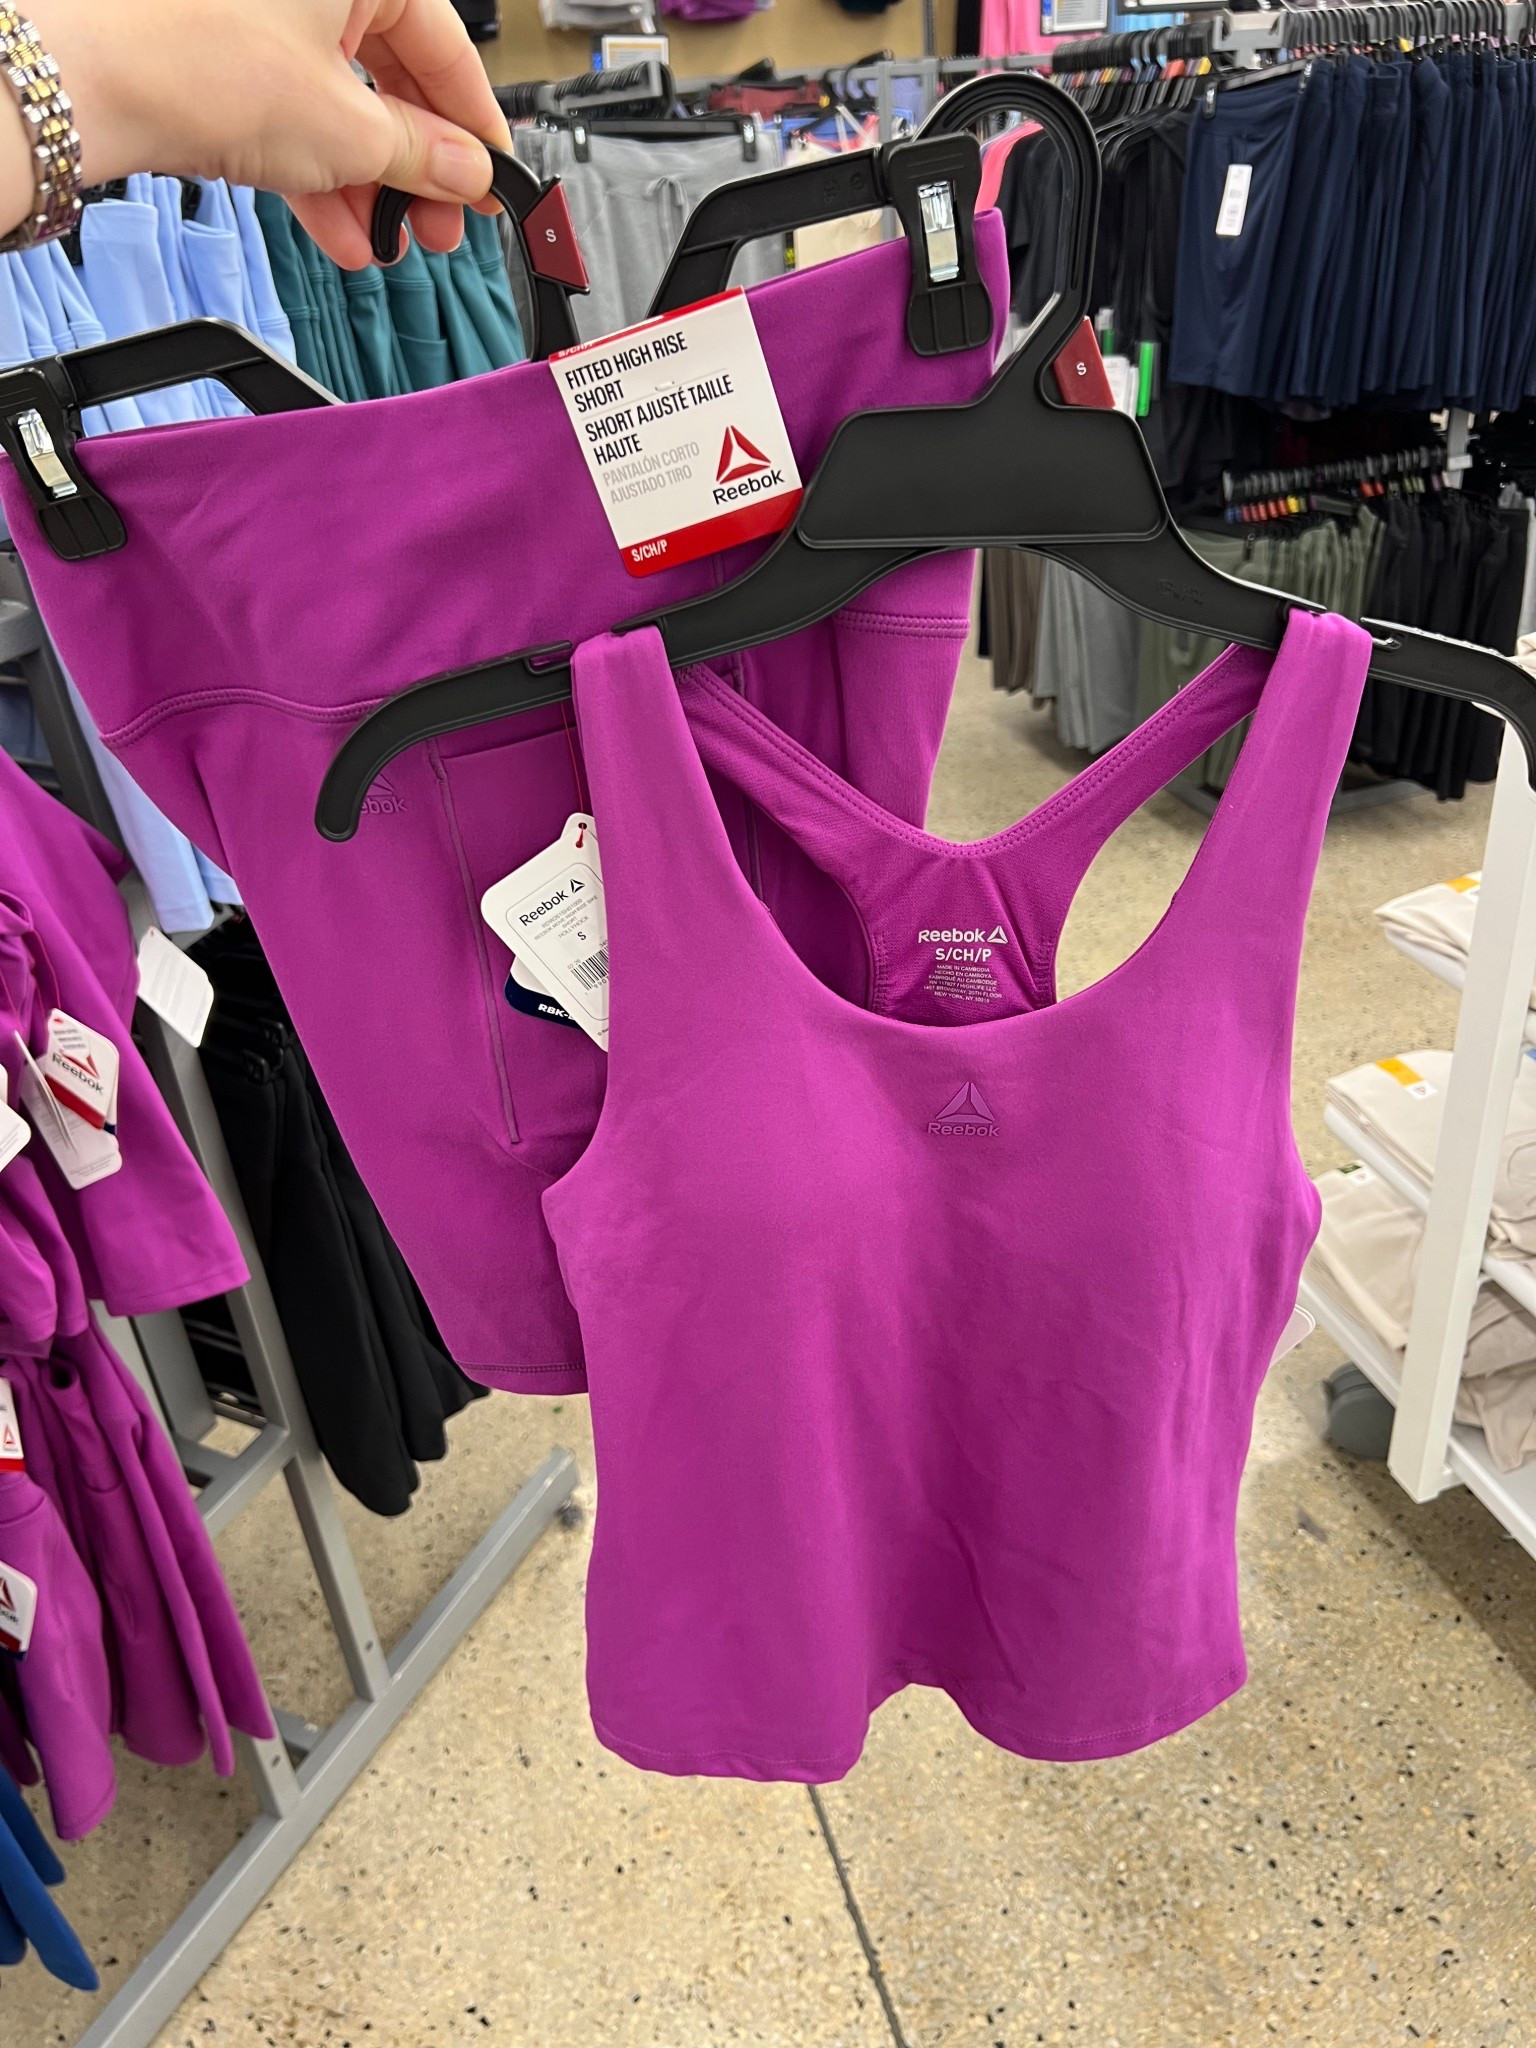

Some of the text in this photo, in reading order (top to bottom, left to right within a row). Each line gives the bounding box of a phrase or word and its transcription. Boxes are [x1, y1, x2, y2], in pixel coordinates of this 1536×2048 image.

[545, 229, 557, 243] S
[565, 331, 688, 390] FITTED HIGH RISE
[1076, 362, 1087, 376] S
[574, 379, 625, 413] SHORT
[585, 374, 734, 442] SHORT AJUSTÉ TAILLE
[593, 433, 643, 466] HAUTE
[602, 441, 700, 487] PANTALÓN CORTO
[610, 464, 693, 504] AJUSTADO TIRO
[712, 469, 785, 505] Reebok
[631, 539, 668, 562] S/CH/P
[360, 796, 408, 814] ebok
[519, 889, 569, 927] Reebok
[577, 931, 587, 941] S
[918, 928, 986, 944] Reebok
[935, 947, 992, 962] S/CH/P
[52, 1053, 104, 1094] Reebok
[927, 1122, 1000, 1137] Reebok
